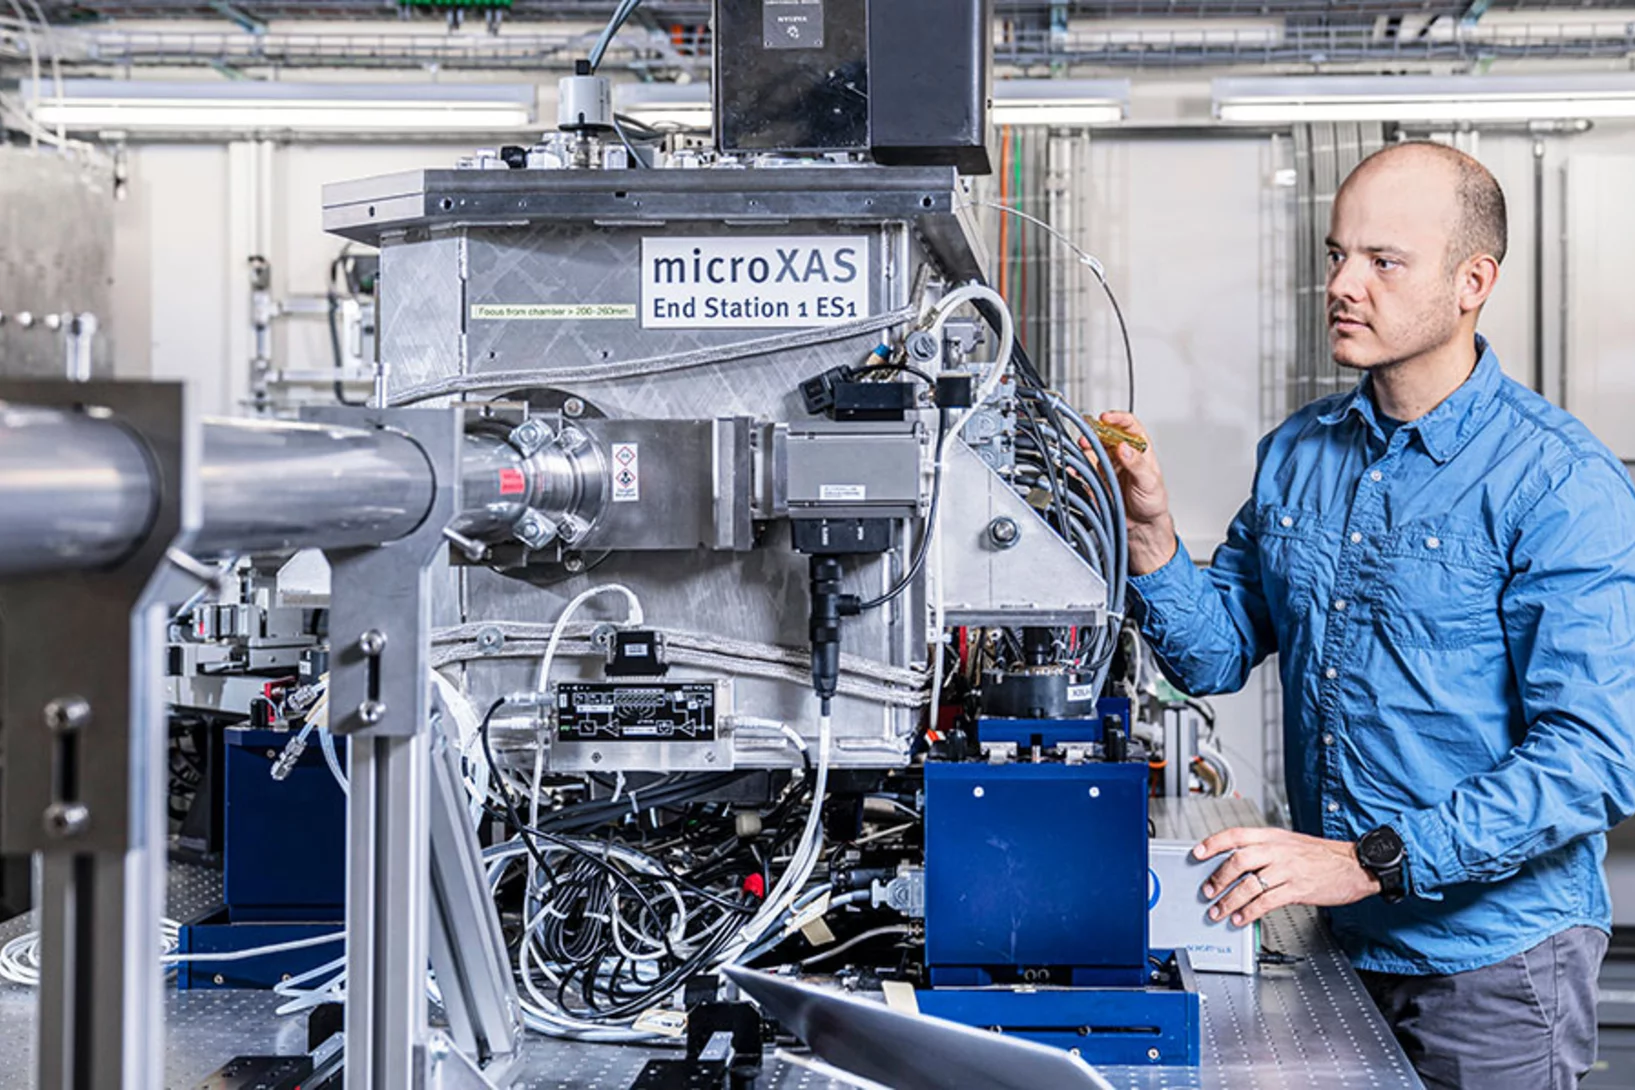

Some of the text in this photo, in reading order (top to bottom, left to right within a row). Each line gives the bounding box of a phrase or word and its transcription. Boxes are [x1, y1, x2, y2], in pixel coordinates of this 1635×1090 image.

[653, 247, 857, 283] microXAS
[478, 307, 505, 316] Focus
[506, 307, 526, 315] from
[528, 307, 565, 315] chamber
[653, 296, 857, 318] End Station 1 ES1
